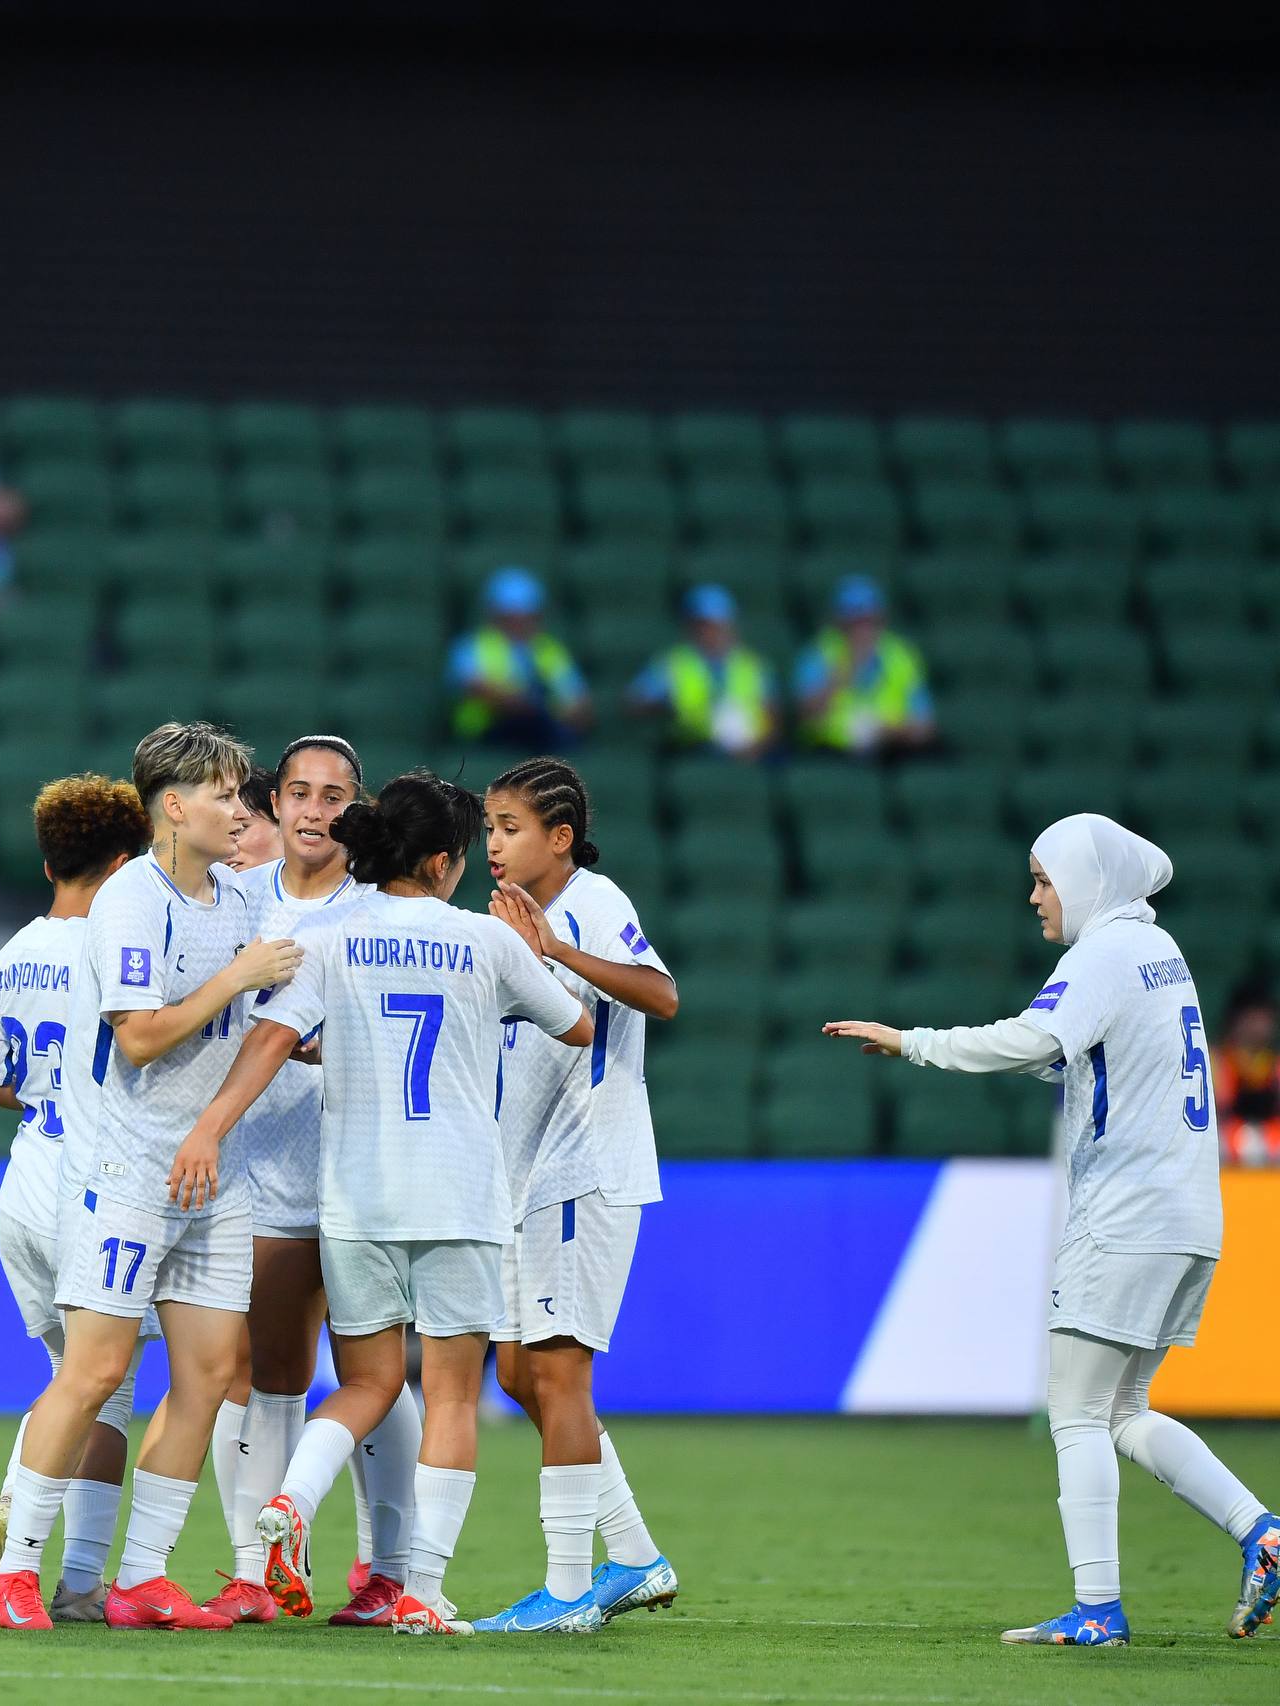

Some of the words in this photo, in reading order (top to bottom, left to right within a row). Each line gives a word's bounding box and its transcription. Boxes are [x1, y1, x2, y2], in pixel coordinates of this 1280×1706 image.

[345, 937, 474, 974] KUDRATOVA
[381, 993, 444, 1121] 7
[1180, 1006, 1210, 1132] 5
[99, 1236, 147, 1295] 17
